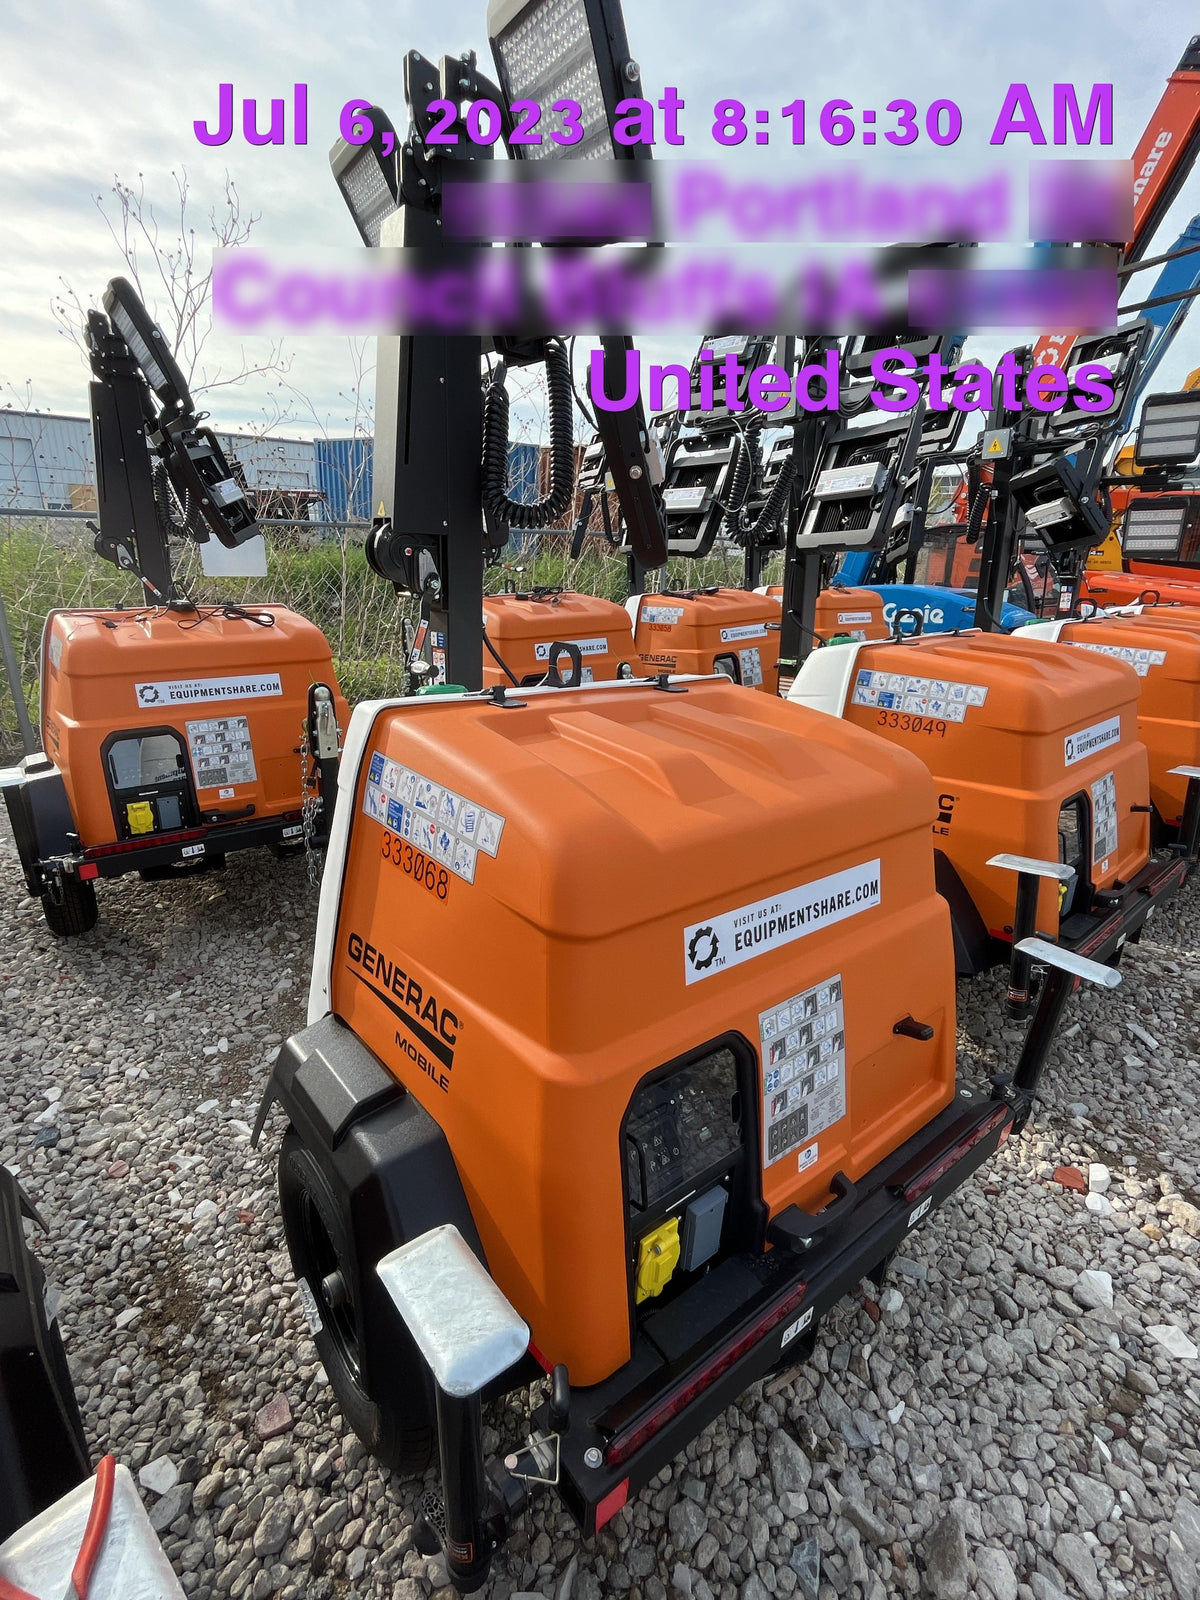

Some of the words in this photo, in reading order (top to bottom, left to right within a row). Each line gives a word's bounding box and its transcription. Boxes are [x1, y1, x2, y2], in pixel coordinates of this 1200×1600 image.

[170, 682, 280, 700] EQUIPMENTSHARE.COM
[877, 710, 947, 738] 333049
[381, 830, 449, 900] 333068
[734, 913, 754, 928] VISIT
[757, 908, 767, 919] US
[771, 903, 782, 914] AT:
[734, 879, 879, 952] EQUIPMENTSHARE.COM
[347, 931, 460, 1046] GENERAC
[395, 1030, 450, 1095] MOBILE
